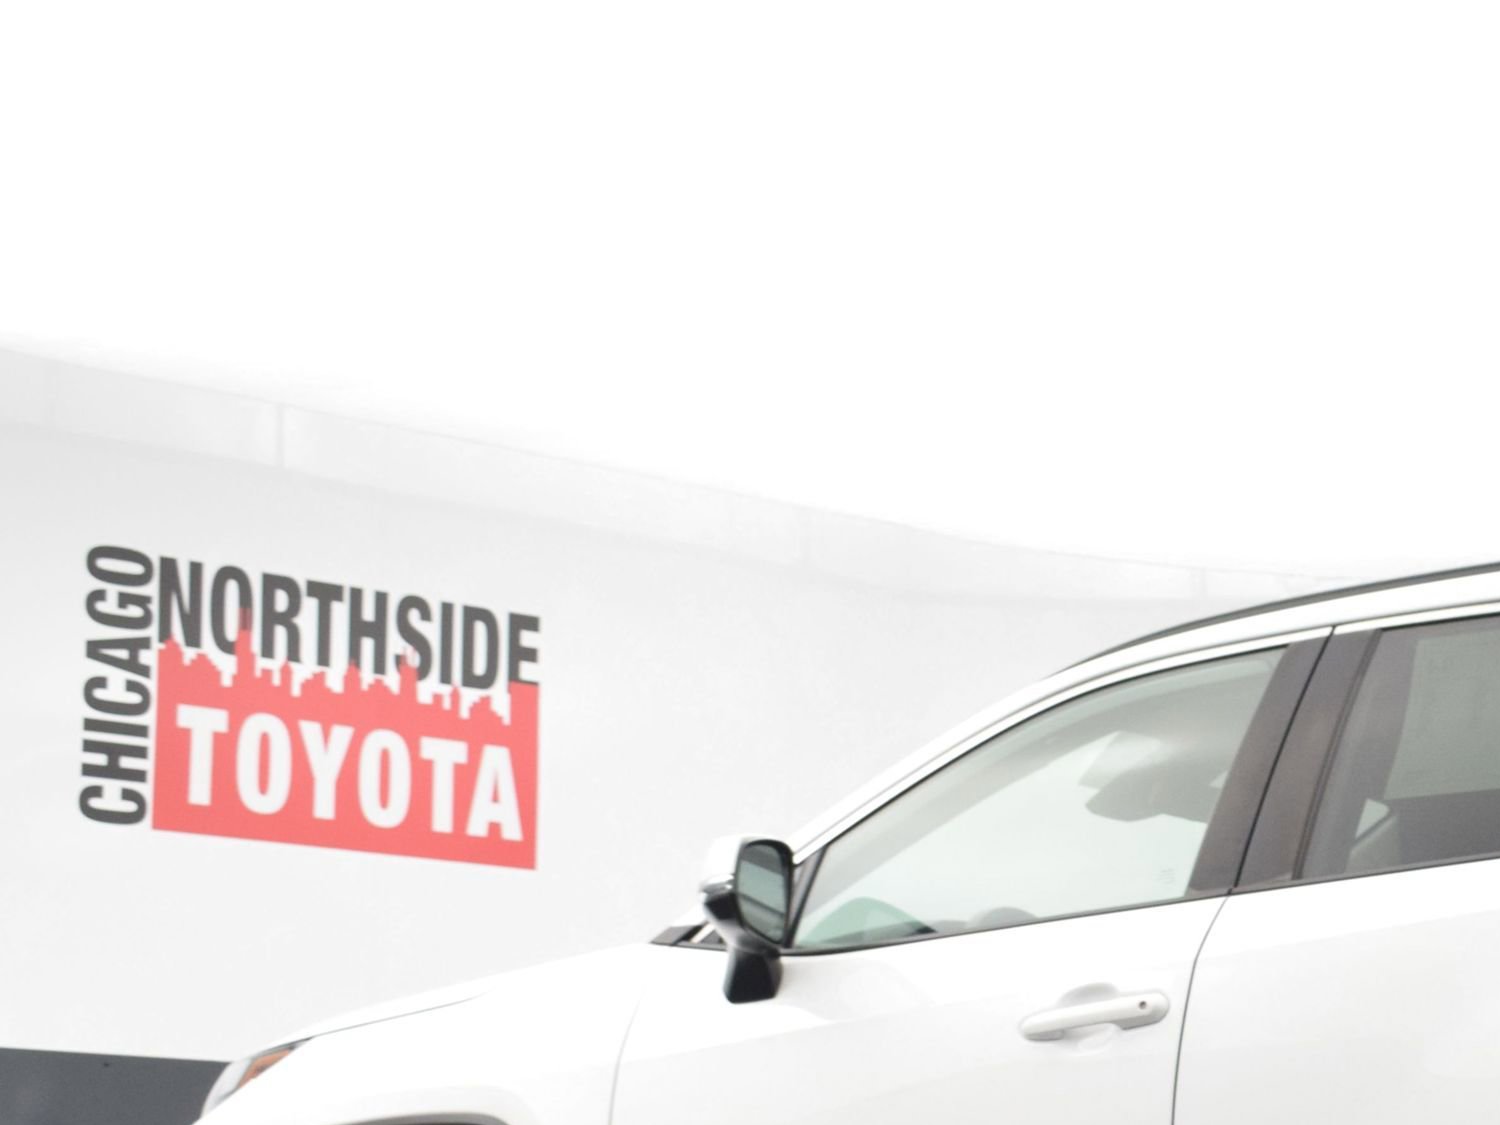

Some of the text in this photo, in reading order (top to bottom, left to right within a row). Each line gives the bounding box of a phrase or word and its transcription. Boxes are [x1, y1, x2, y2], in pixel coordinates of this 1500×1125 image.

[78, 545, 154, 826] CHICAGO
[157, 555, 541, 690] NORTHSIDE
[175, 703, 524, 843] TOYOTA
